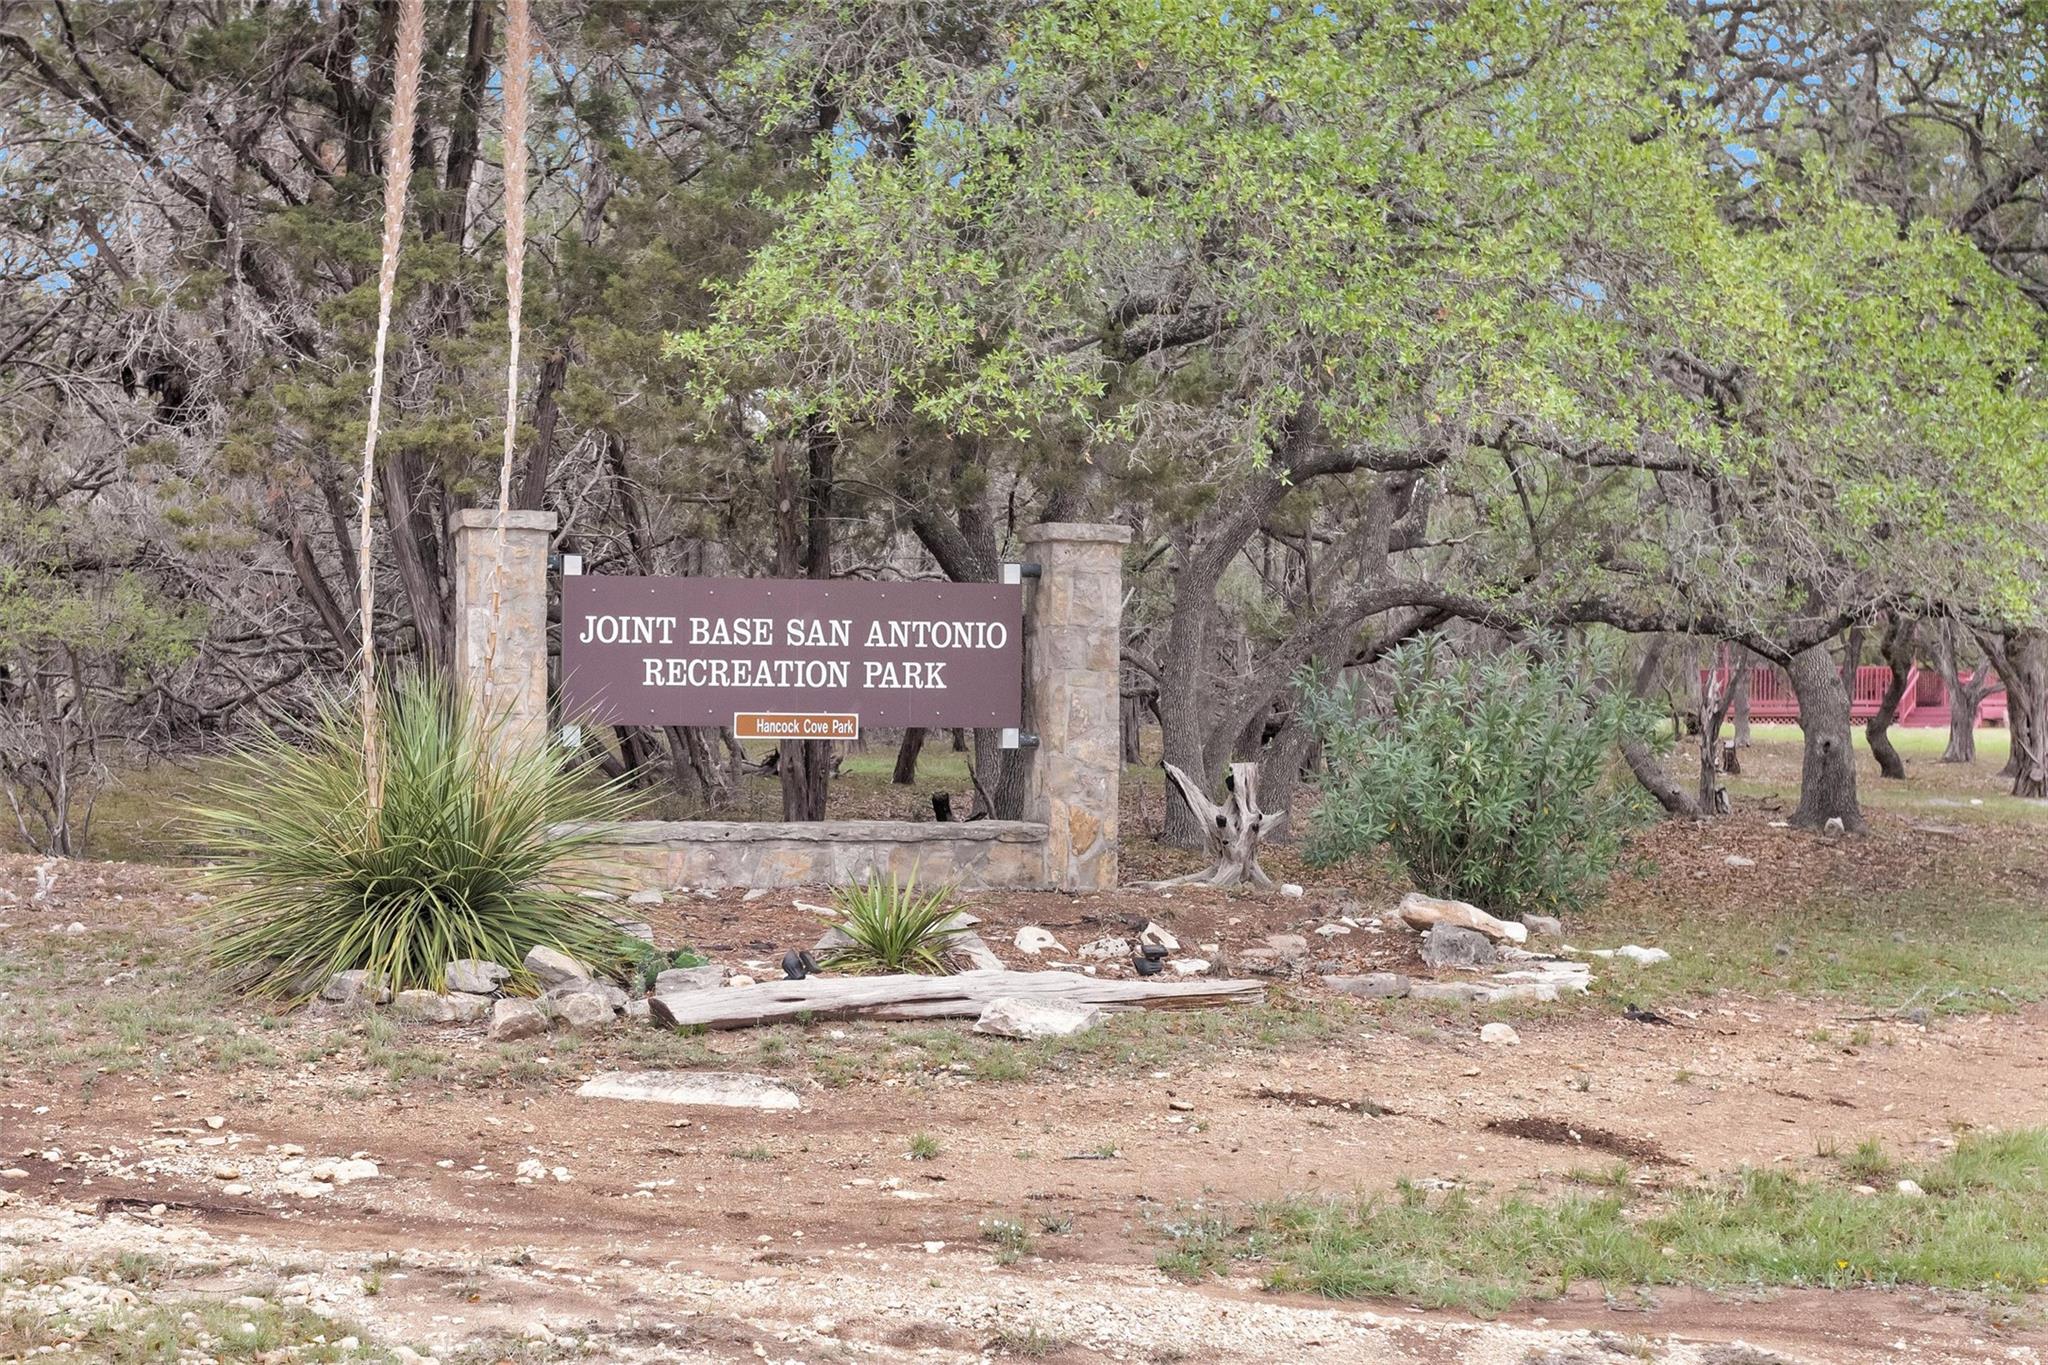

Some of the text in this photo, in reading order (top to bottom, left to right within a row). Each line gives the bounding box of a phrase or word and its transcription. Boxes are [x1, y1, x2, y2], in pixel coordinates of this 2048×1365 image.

[579, 615, 1008, 649] JOINT BASE SAN ANTONIO
[642, 658, 948, 690] RECREATION PARK
[756, 718, 854, 734] Hancock Cove Park
